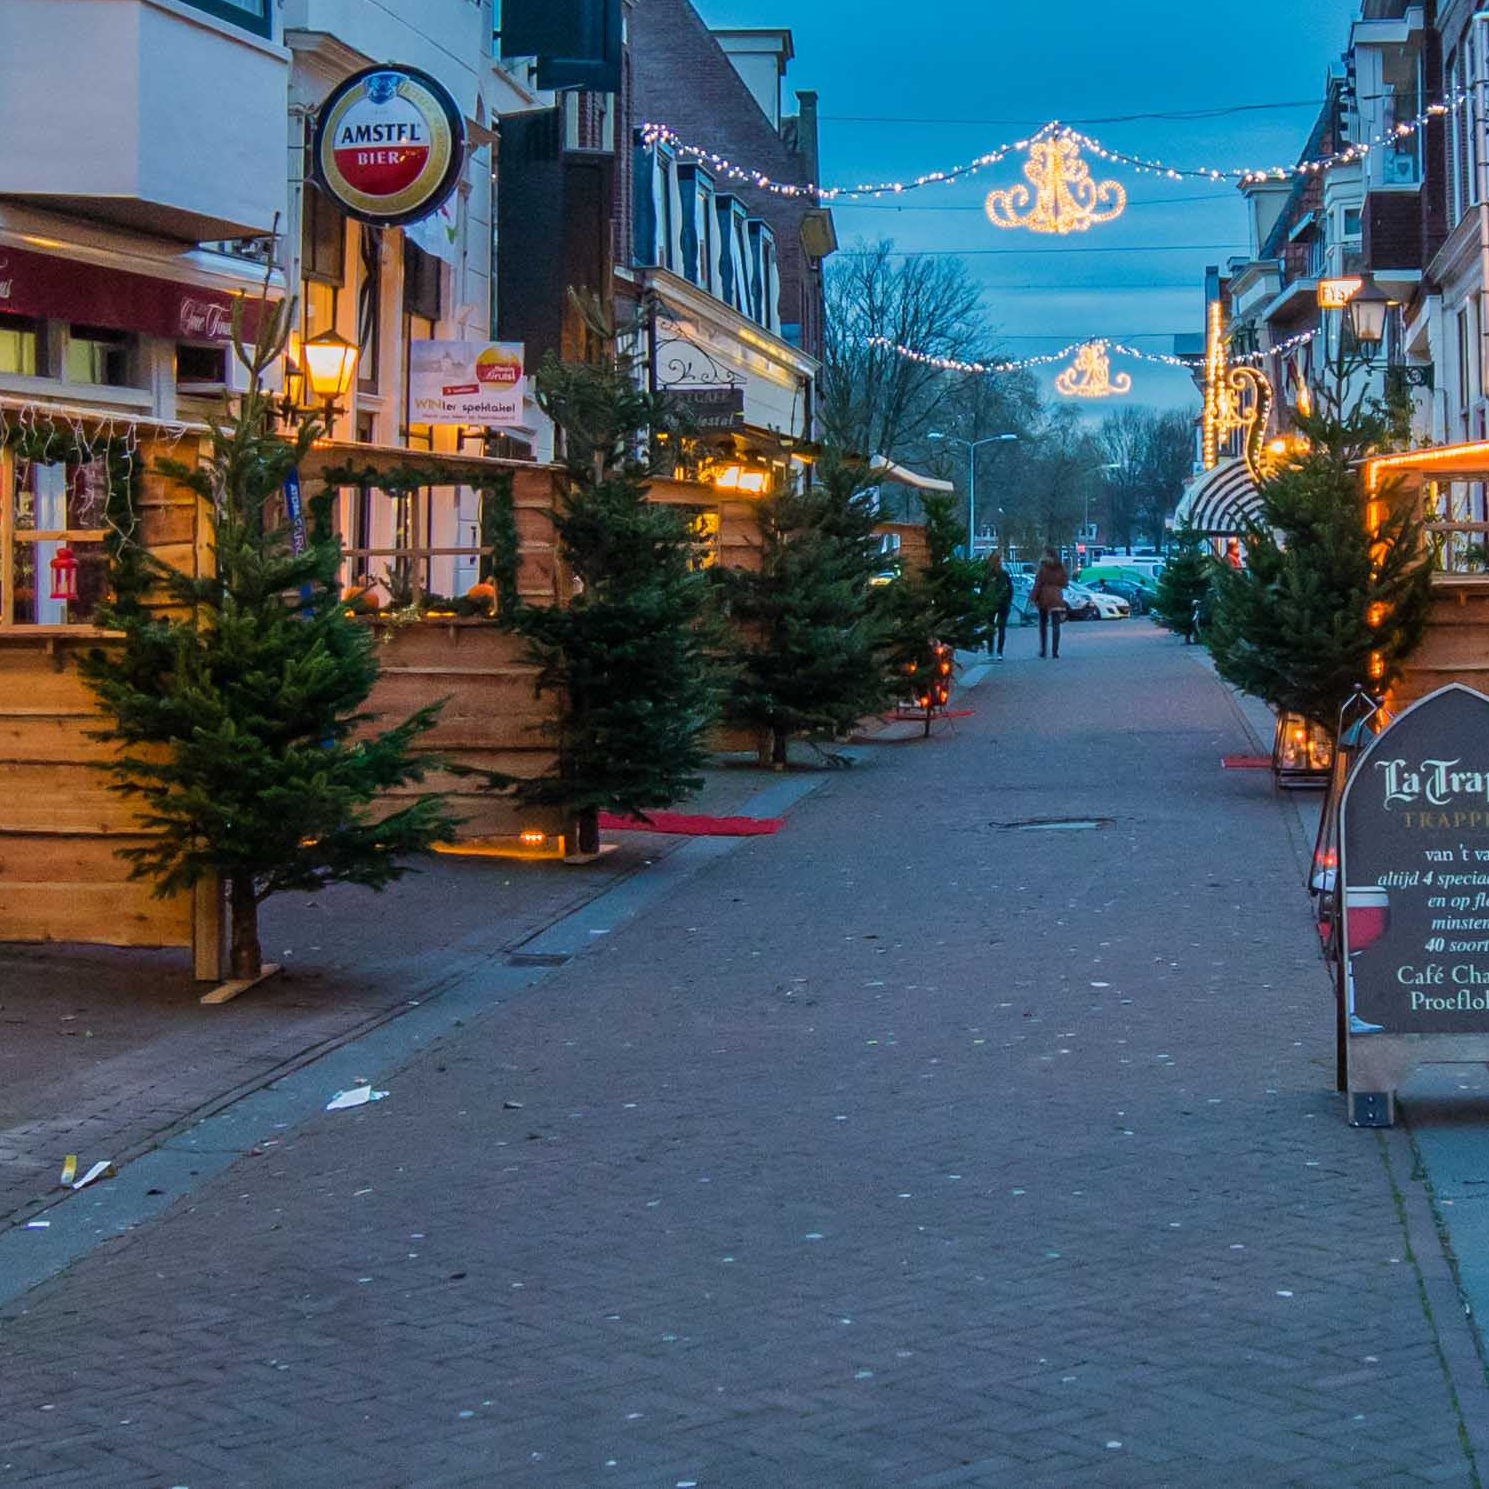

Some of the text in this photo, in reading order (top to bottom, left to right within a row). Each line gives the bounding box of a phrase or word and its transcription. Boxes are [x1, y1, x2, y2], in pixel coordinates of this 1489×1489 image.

[341, 122, 421, 145] AMSTEL
[357, 150, 400, 166] BIER
[1375, 758, 1421, 810] La
[1424, 849, 1454, 863] van
[1458, 843, 1470, 863] 't
[1376, 870, 1420, 888] altijd
[1422, 870, 1435, 886] 4
[1427, 896, 1446, 909] en
[1450, 896, 1471, 912] op
[1425, 937, 1445, 953] 40
[1396, 966, 1444, 986] Café
